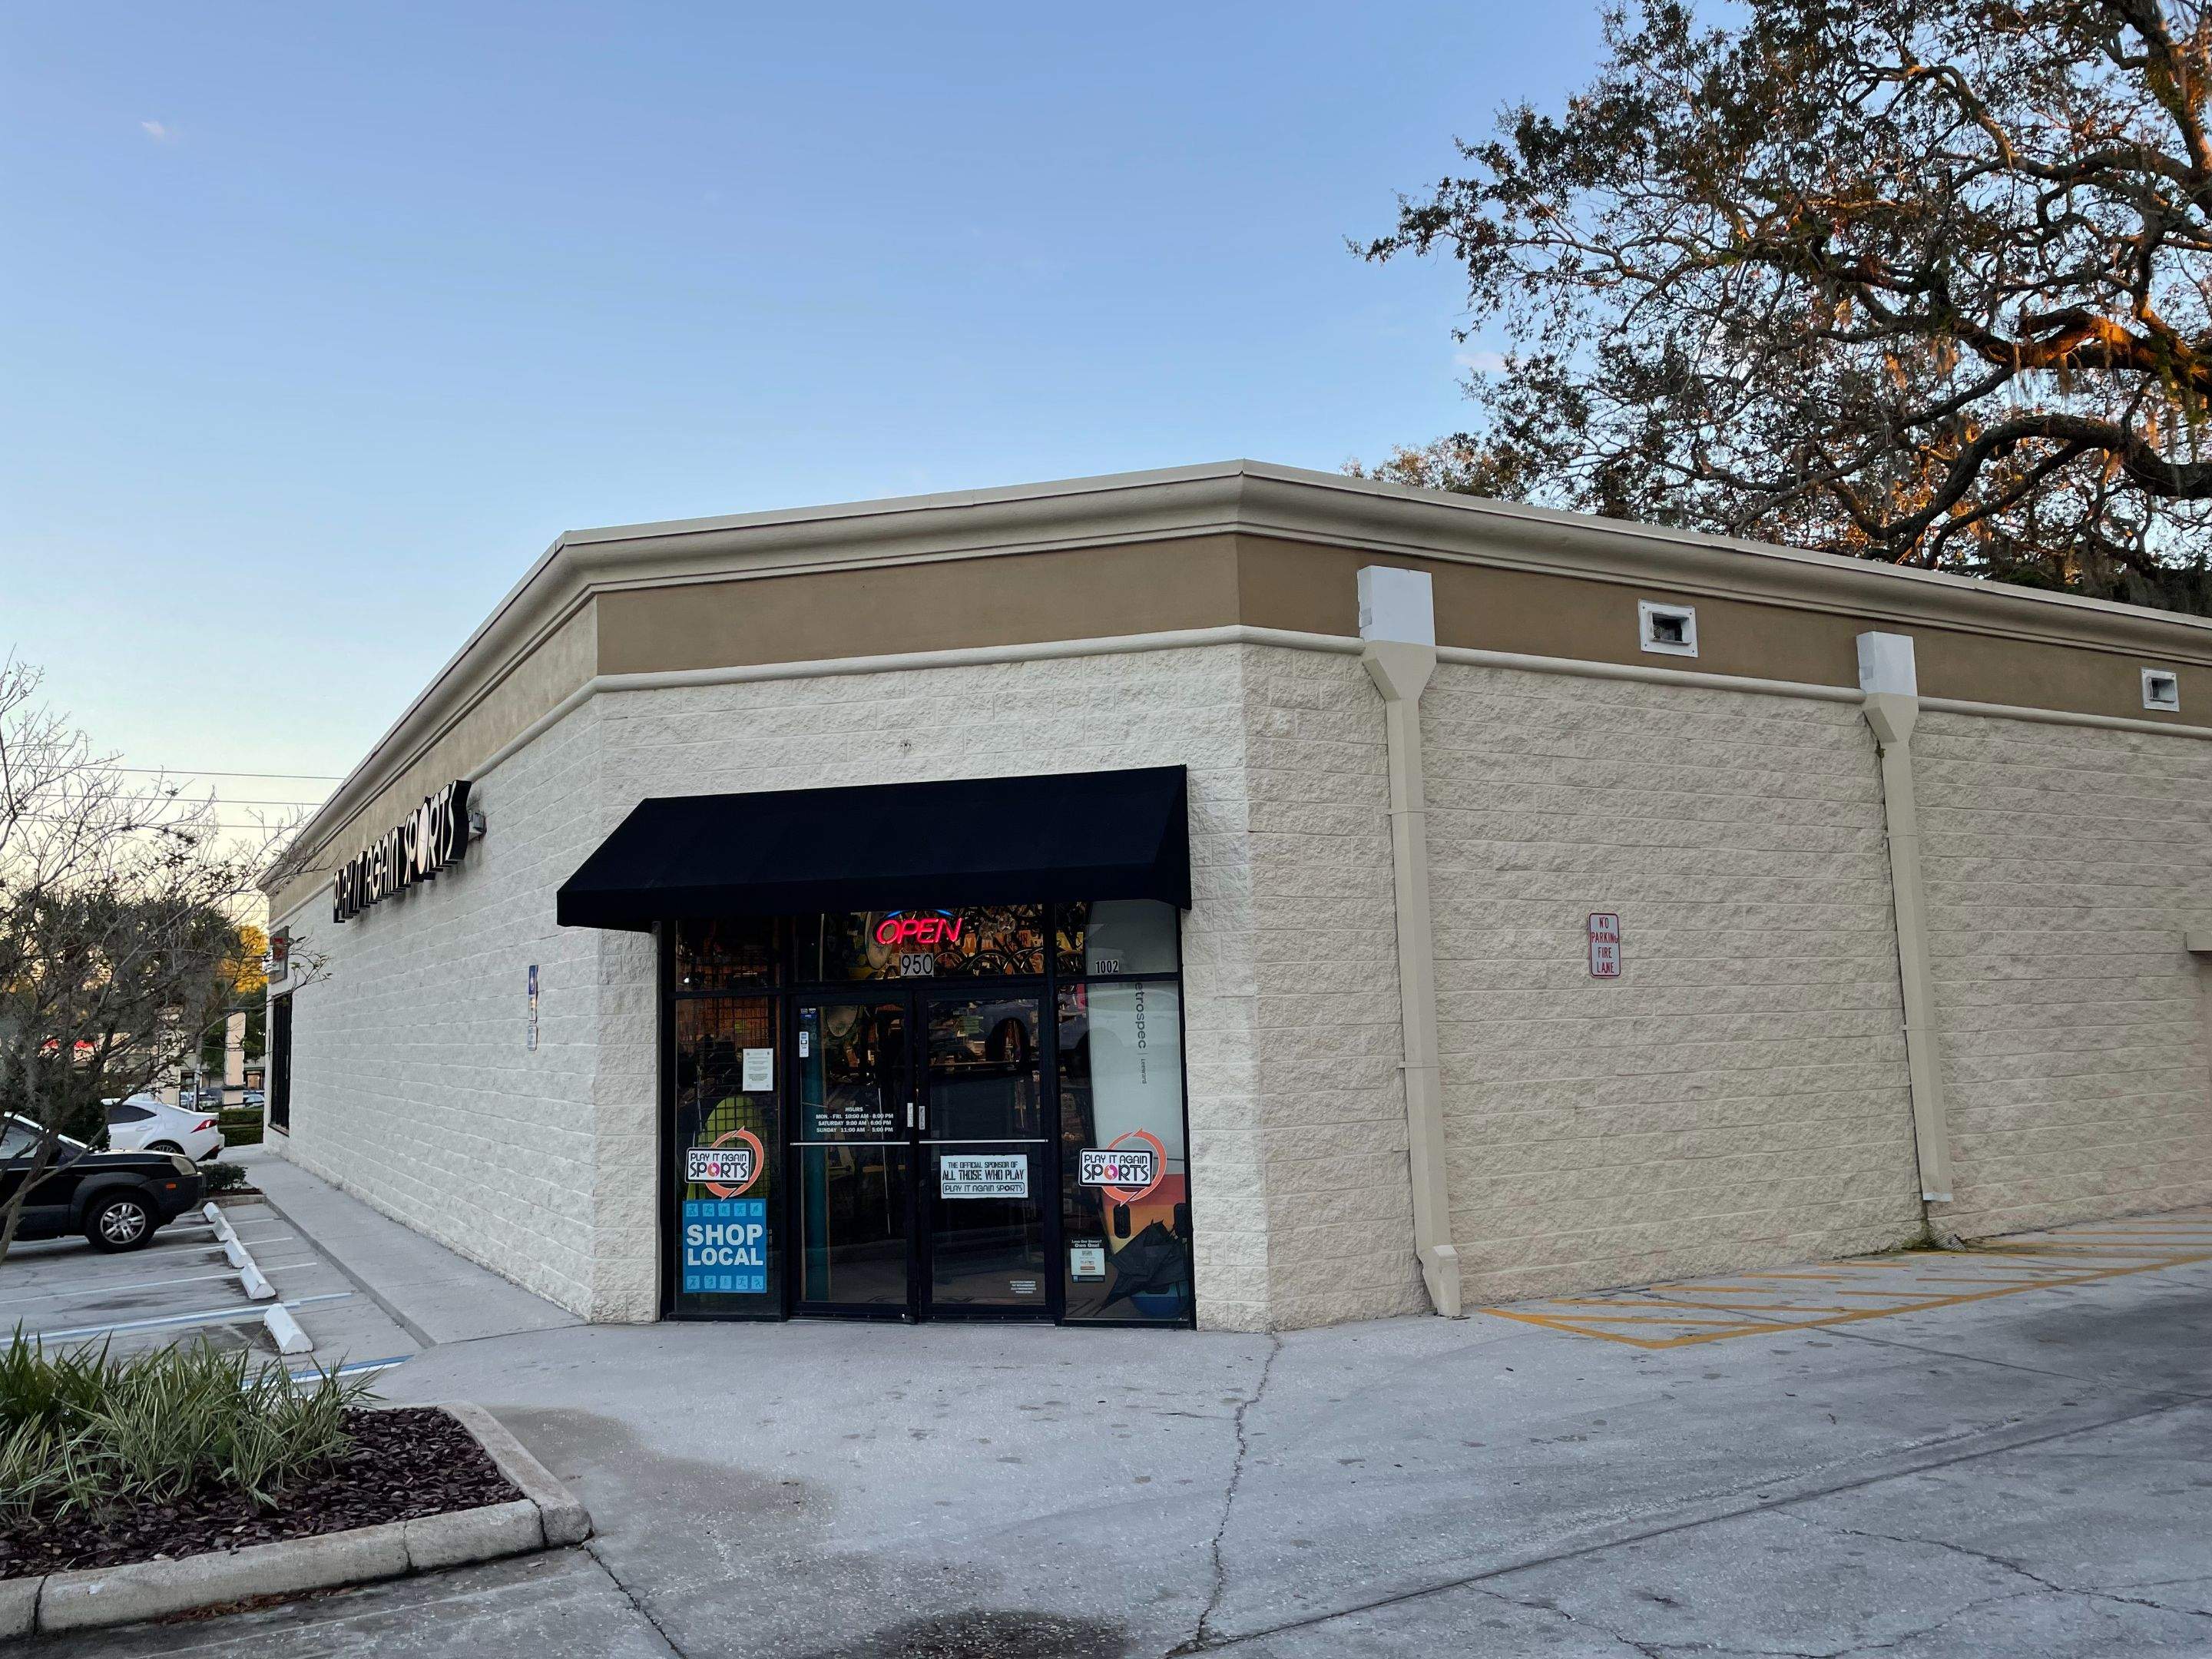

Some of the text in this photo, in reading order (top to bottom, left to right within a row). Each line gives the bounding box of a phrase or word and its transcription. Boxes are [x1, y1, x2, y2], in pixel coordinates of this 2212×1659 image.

[404, 780, 463, 885] SPORTS
[1599, 916, 1609, 929] NO
[876, 917, 962, 945] OPEN
[1591, 932, 1618, 944] PARKING
[1598, 947, 1613, 959] FIRE
[902, 953, 933, 975] 950
[1095, 960, 1119, 974] 1002
[1597, 962, 1614, 974] LANE
[1134, 982, 1147, 1049] etrospec
[690, 1153, 747, 1162] PLAY IT AGAIN
[1084, 1154, 1147, 1164] PLAY IT AGAIN
[690, 1161, 747, 1178] SPORTS
[942, 1169, 1025, 1181] ALL THOSE WHO PLAY
[1084, 1164, 1149, 1181] SPORTS
[687, 1224, 763, 1247] SHOP
[687, 1247, 764, 1266] LOCAL
